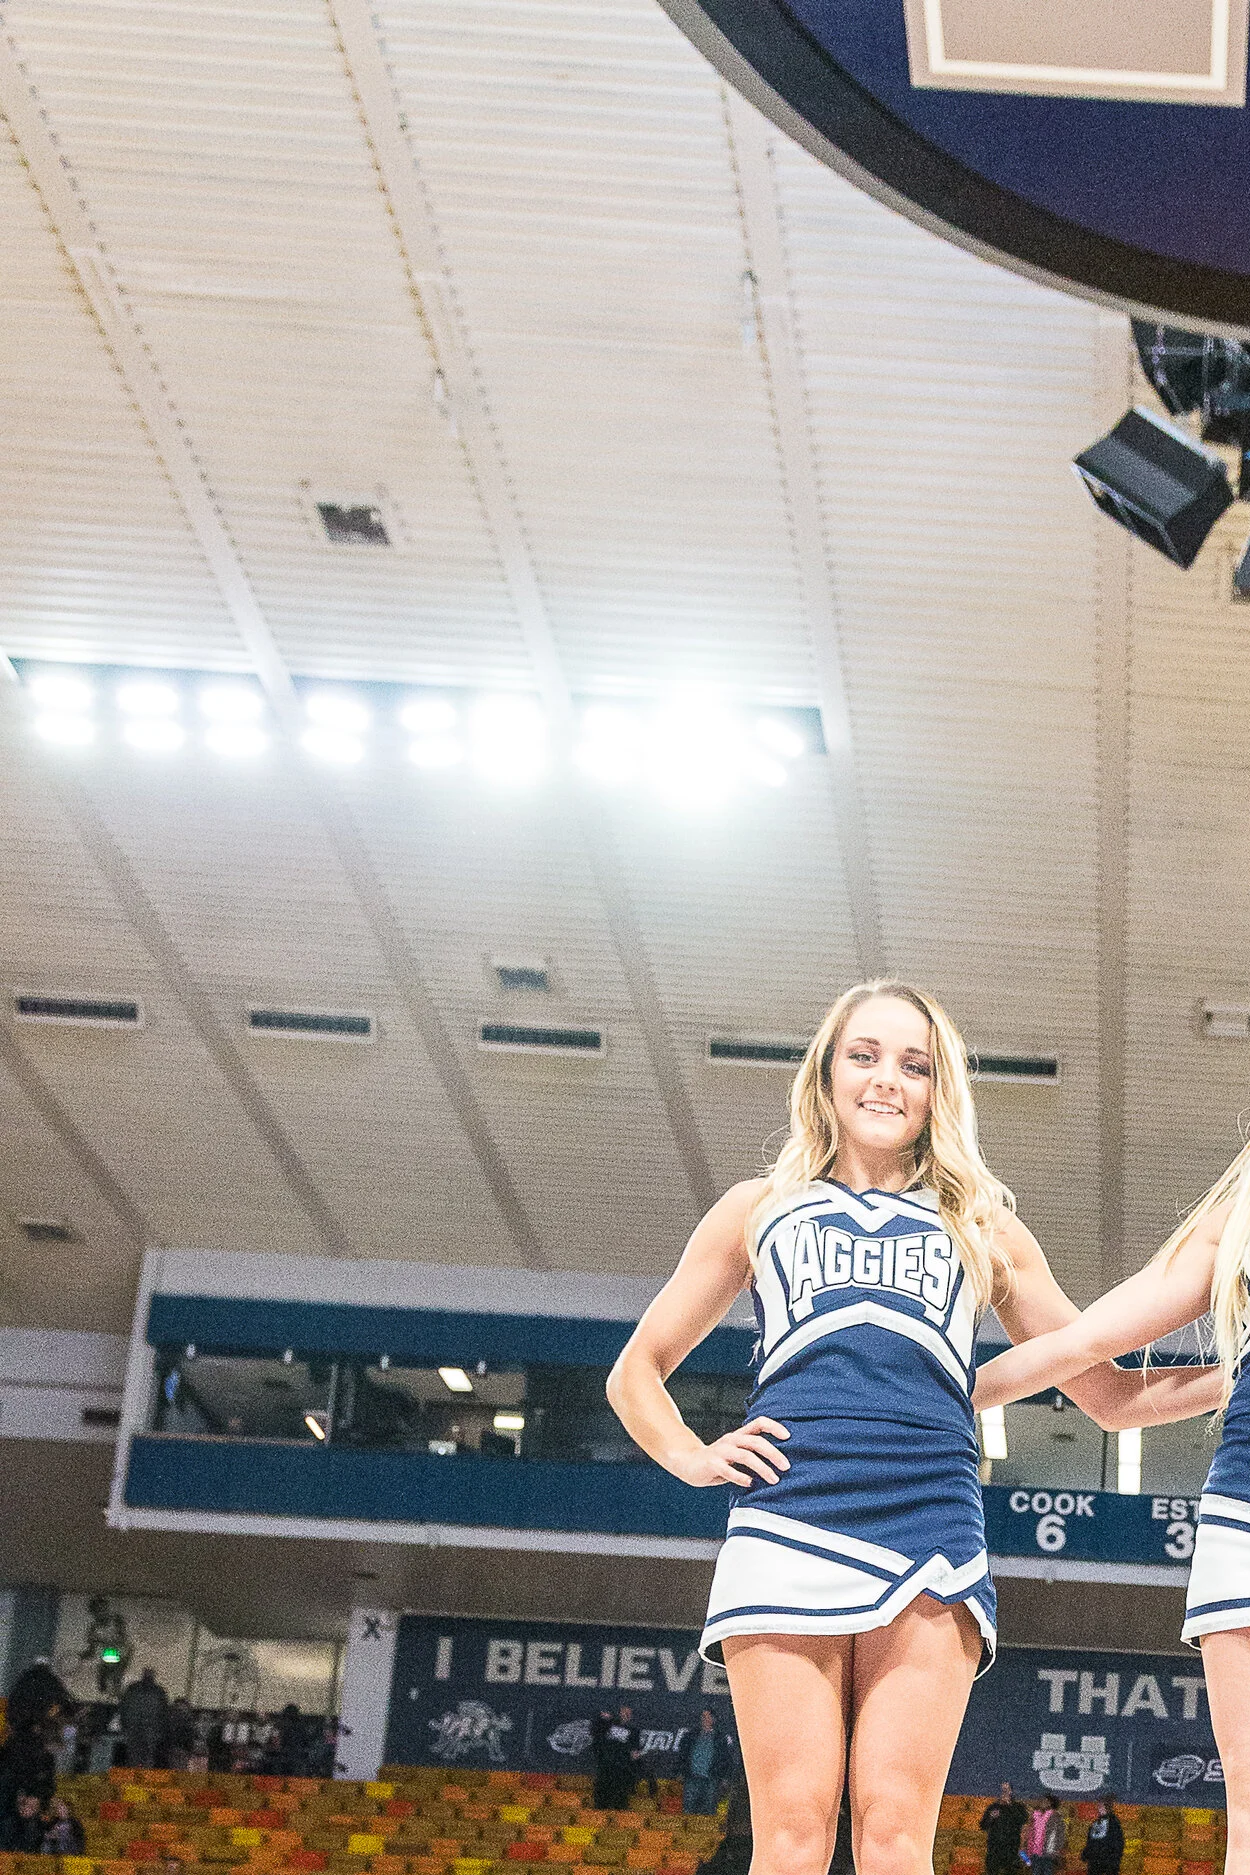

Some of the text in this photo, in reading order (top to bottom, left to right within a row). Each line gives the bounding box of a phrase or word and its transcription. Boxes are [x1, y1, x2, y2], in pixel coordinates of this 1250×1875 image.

[791, 1220, 953, 1311] AGGIES
[1009, 1490, 1096, 1518] COOK
[1035, 1513, 1067, 1552] 6
[1164, 1520, 1196, 1560] 3
[363, 1615, 381, 1640] X
[433, 1635, 454, 1681] I
[1037, 1668, 1207, 1721] THAT
